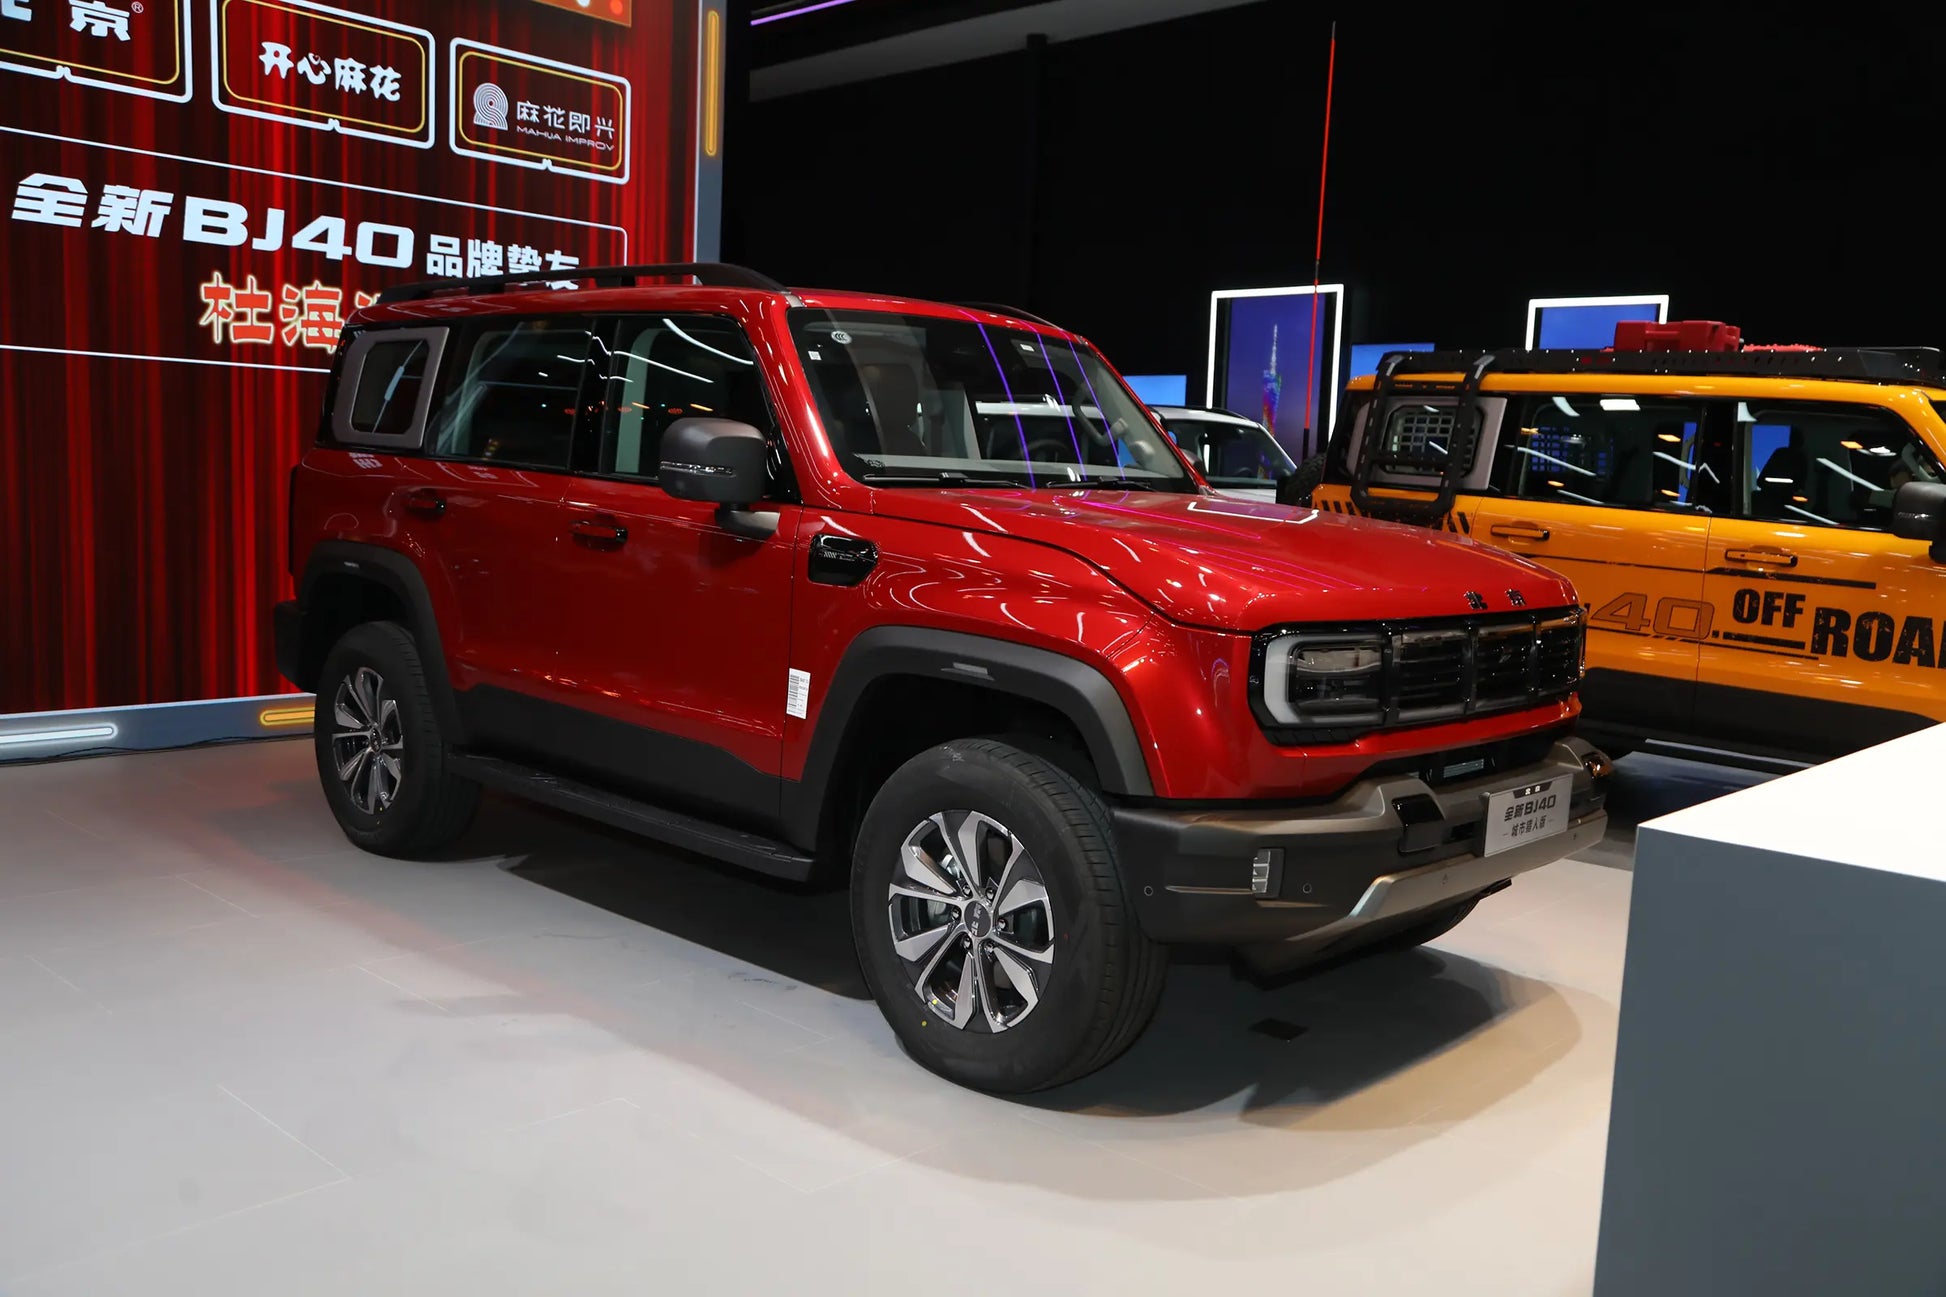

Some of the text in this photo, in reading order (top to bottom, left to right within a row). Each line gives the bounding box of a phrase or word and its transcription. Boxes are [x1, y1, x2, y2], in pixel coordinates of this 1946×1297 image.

[259, 41, 402, 102] 开心麻花
[516, 100, 615, 139] 麻花即兴
[516, 125, 615, 151] MAHUA IMPROV
[199, 271, 382, 354] 杜海
[1732, 588, 1806, 628] OFF
[1810, 606, 1946, 669] ROA
[1504, 794, 1557, 822] 全新BJ40
